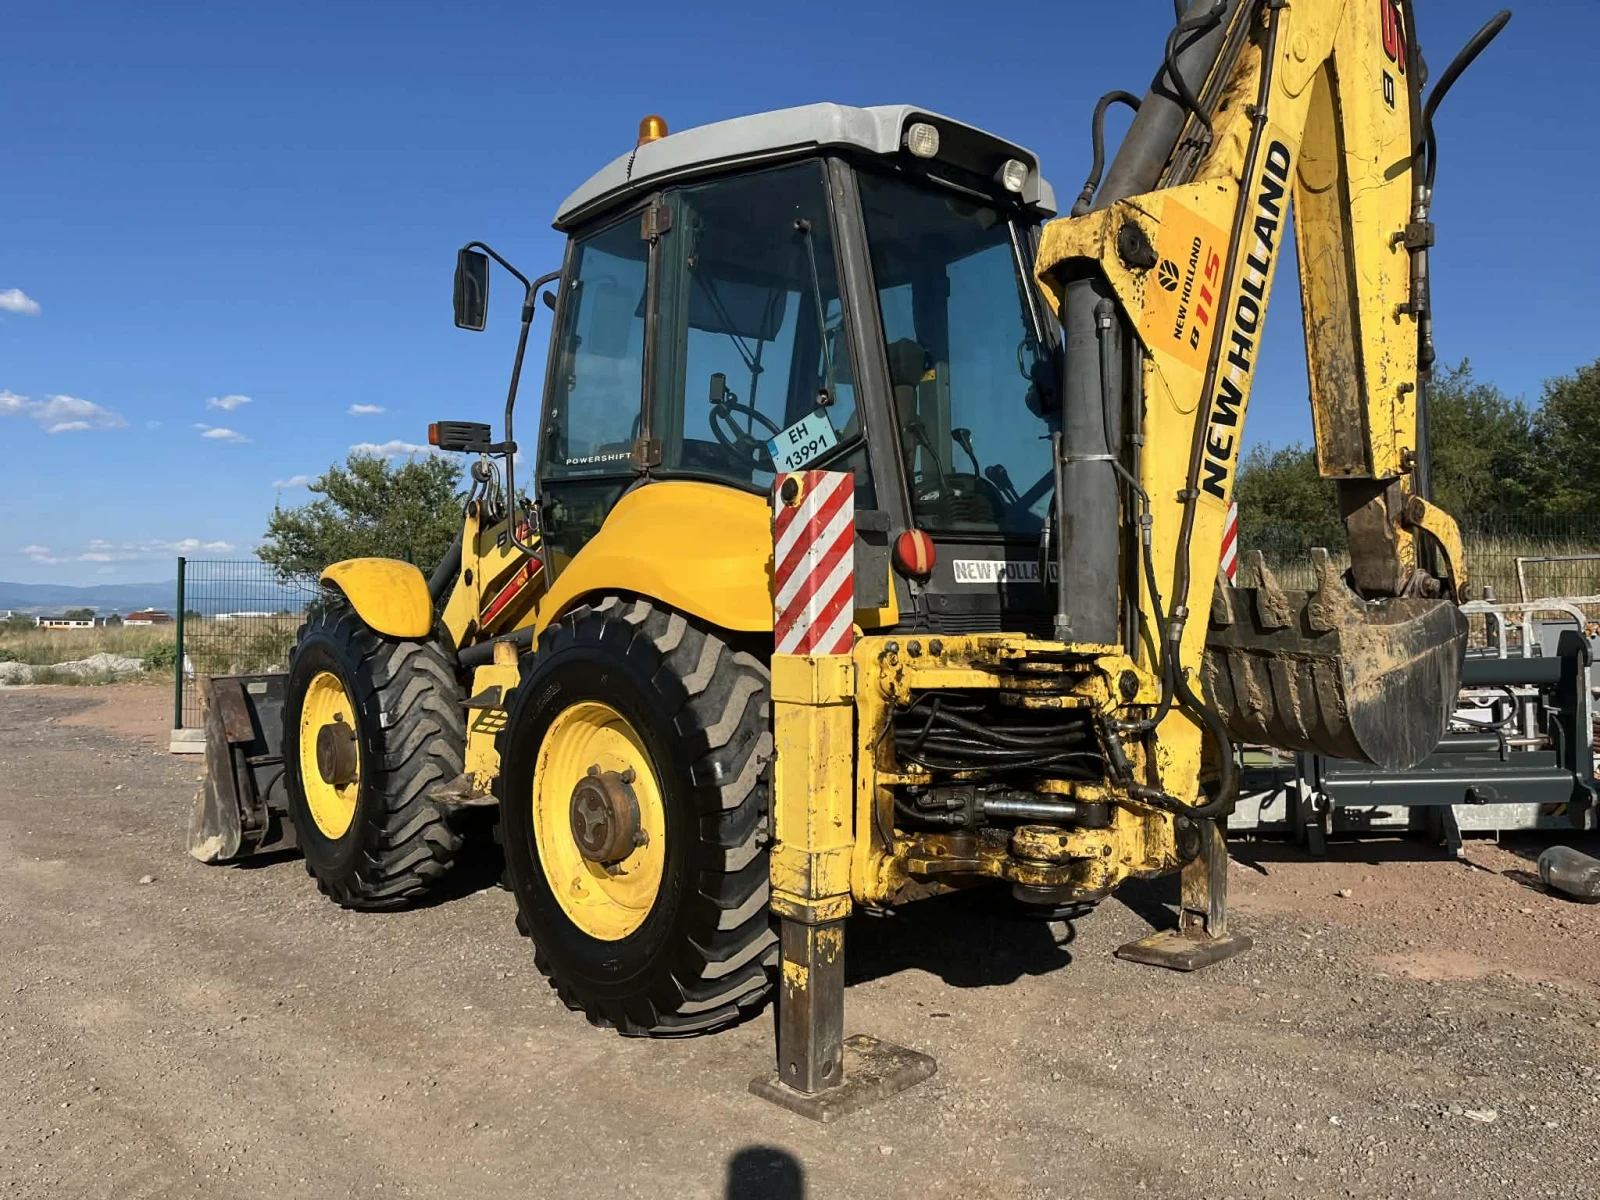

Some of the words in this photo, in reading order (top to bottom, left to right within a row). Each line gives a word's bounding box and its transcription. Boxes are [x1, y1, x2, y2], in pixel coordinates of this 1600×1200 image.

[1173, 305, 1187, 341] NEW
[1181, 236, 1202, 304] HOLLAND
[1202, 376, 1243, 500] NEW
[1227, 139, 1291, 373] HOLLAND
[788, 422, 809, 445] EH
[566, 452, 632, 465] POWERSHIFT
[785, 434, 828, 469] 13991
[954, 562, 991, 580] NEW
[994, 562, 1059, 580] HOLLAD
